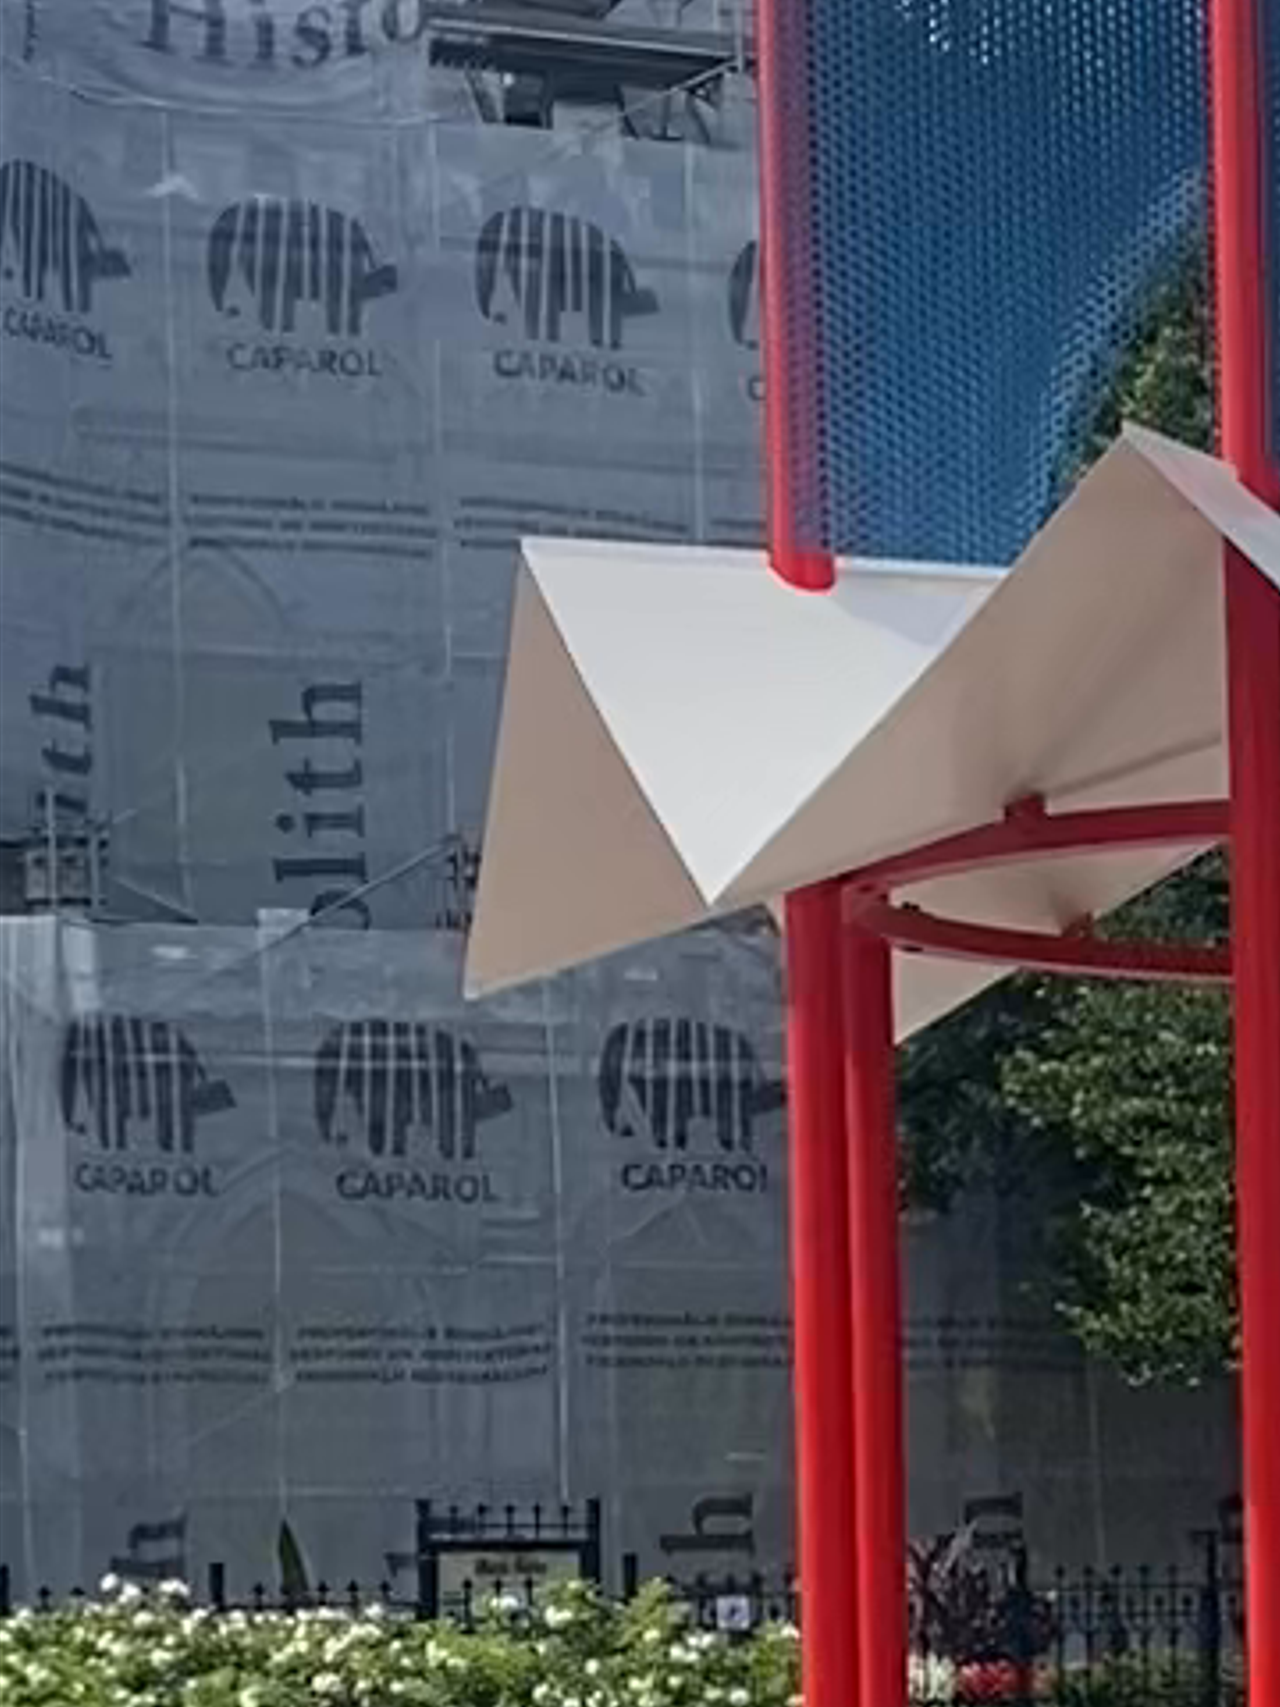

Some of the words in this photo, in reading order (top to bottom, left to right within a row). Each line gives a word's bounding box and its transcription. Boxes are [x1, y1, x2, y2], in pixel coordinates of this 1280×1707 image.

[226, 342, 382, 377] CAPAROL
[493, 349, 648, 396] CAPAROL
[74, 1161, 216, 1197] CAPAROL
[335, 1169, 500, 1204] CAPAROL
